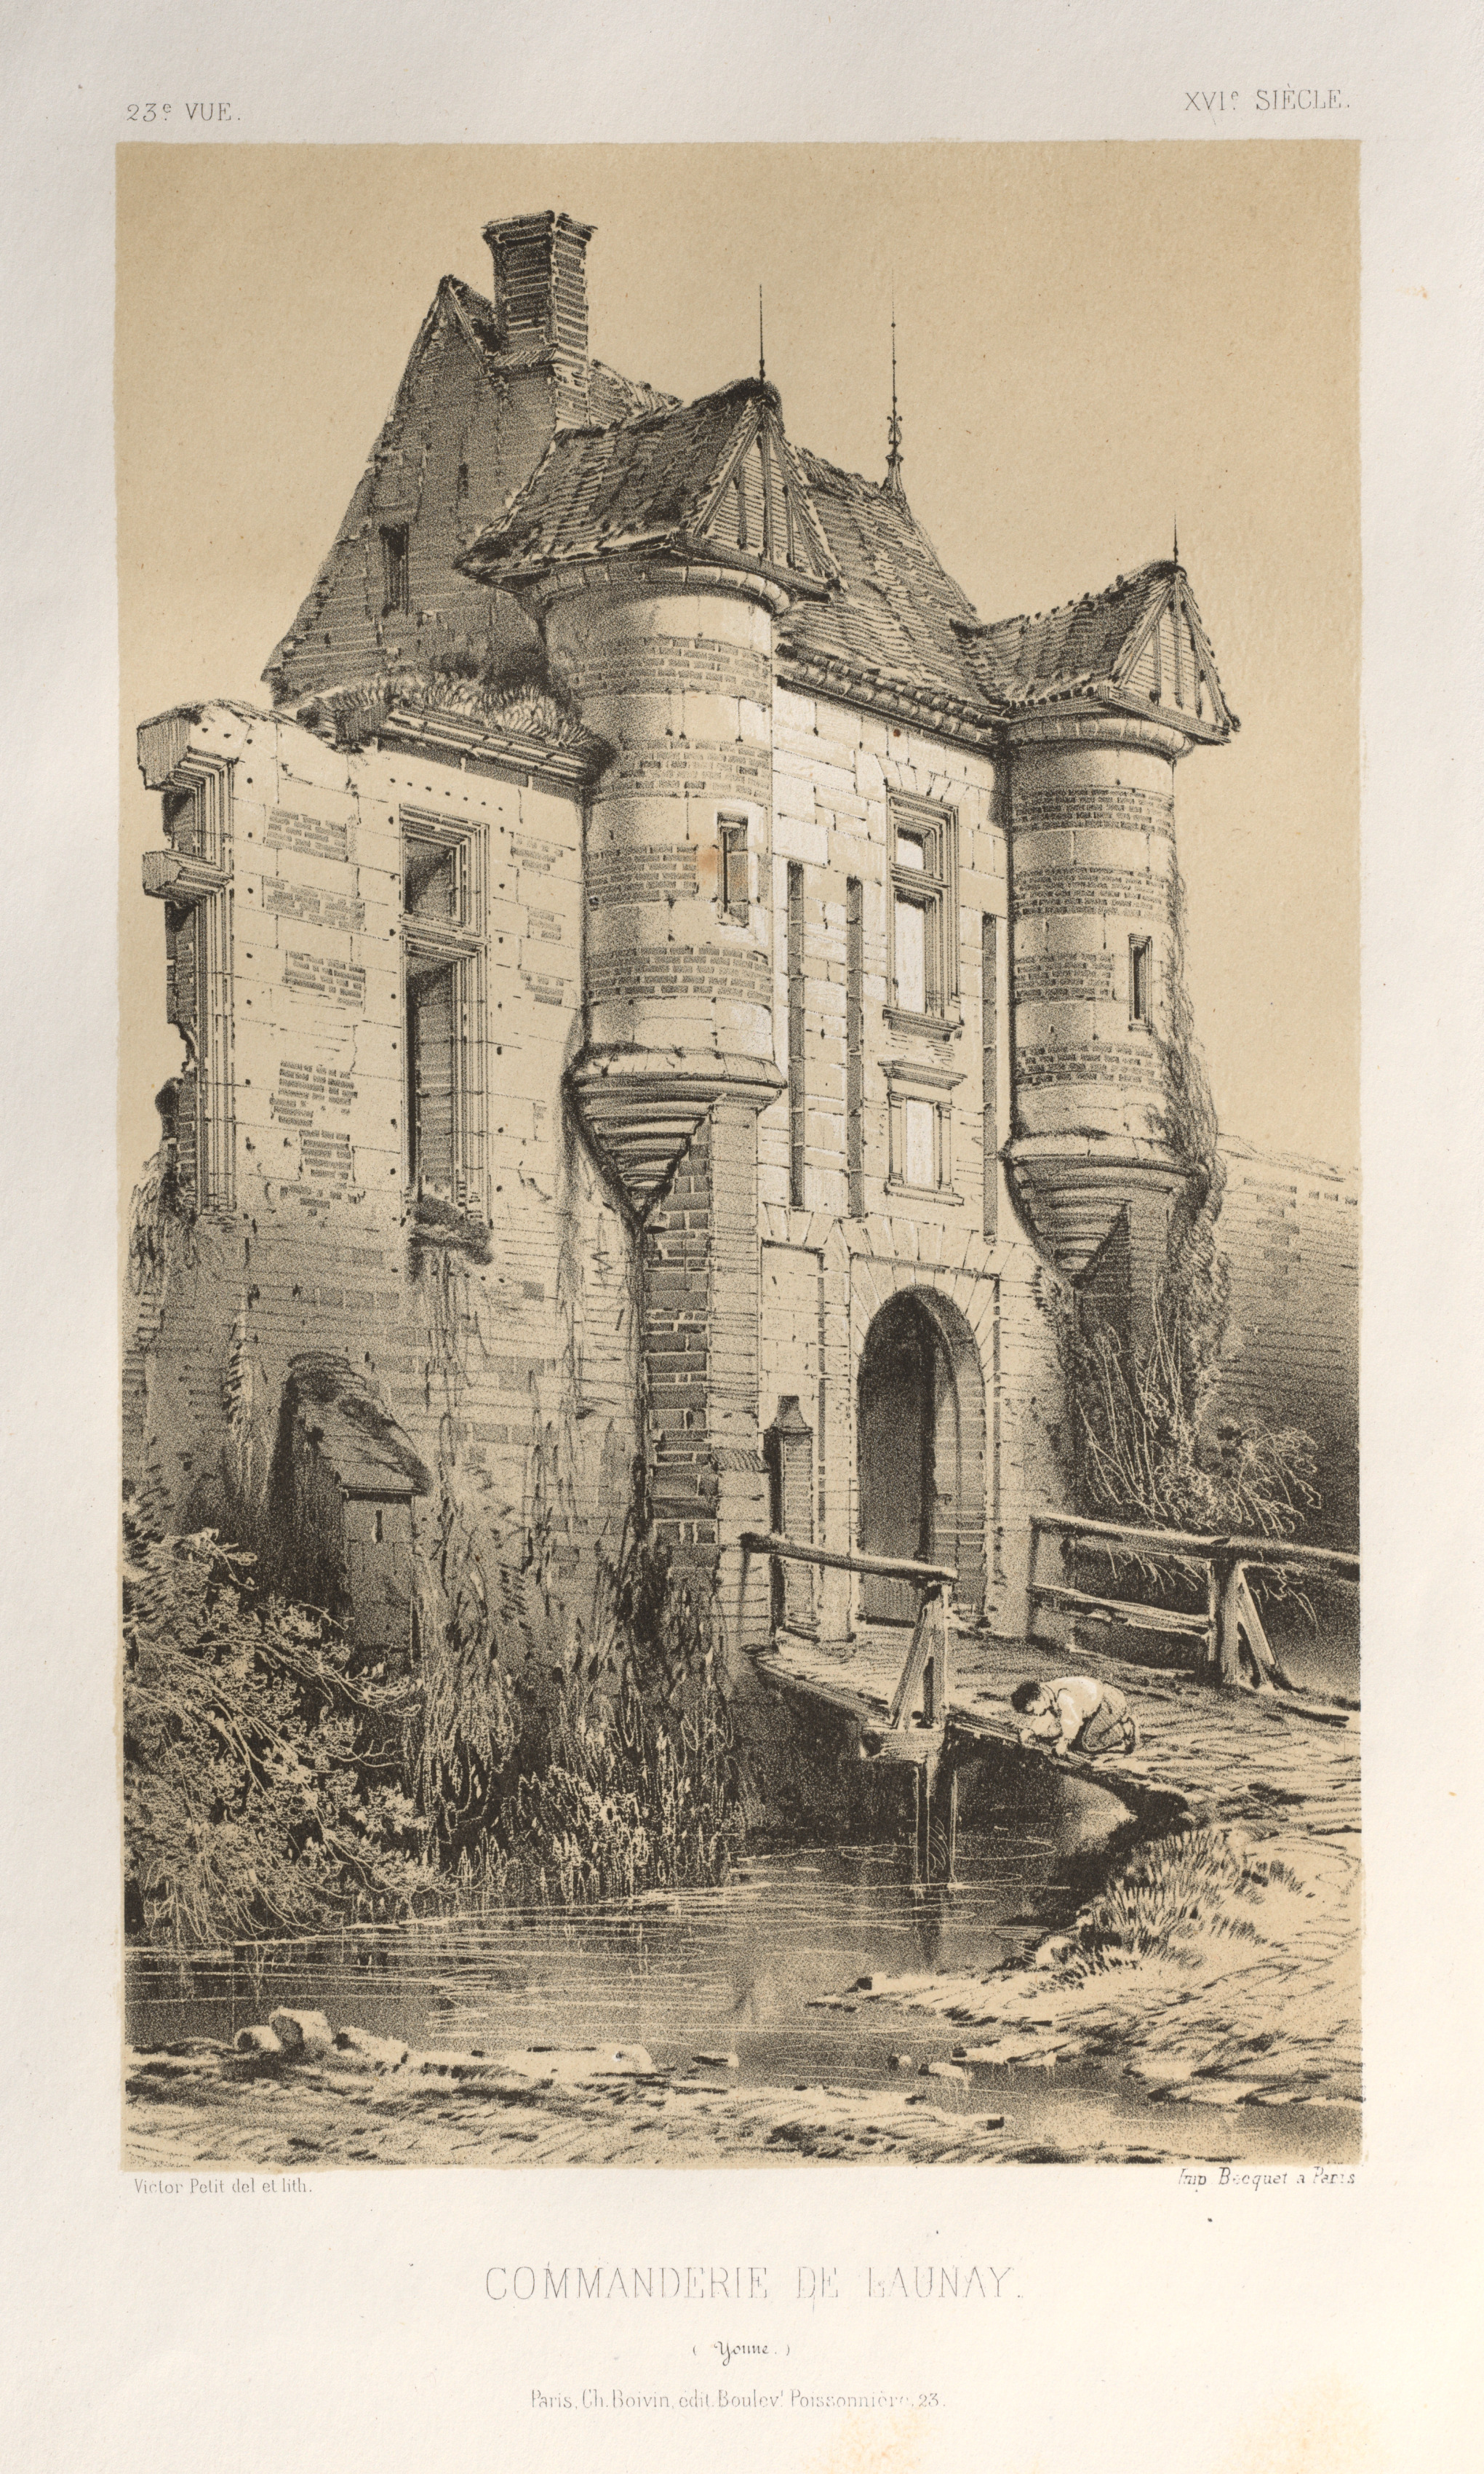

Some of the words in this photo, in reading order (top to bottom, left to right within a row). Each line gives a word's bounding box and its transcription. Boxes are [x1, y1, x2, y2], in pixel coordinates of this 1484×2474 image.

[1256, 83, 1350, 111] SIÈCLE.
[186, 103, 241, 122] VUE.
[134, 2178, 183, 2193] Victor
[189, 2178, 225, 2194] Petit
[232, 2178, 255, 2193] del
[262, 2179, 277, 2192] et
[282, 2178, 313, 2192] lith.
[485, 2266, 767, 2300] COMMANDERIE
[797, 2266, 839, 2299] DE
[865, 2266, 1024, 2298] LAUNAY.
[531, 2389, 578, 2410] Paris,
[582, 2389, 609, 2409] Ch.
[613, 2389, 675, 2410] Boivin,
[918, 2392, 946, 2408] 23.
